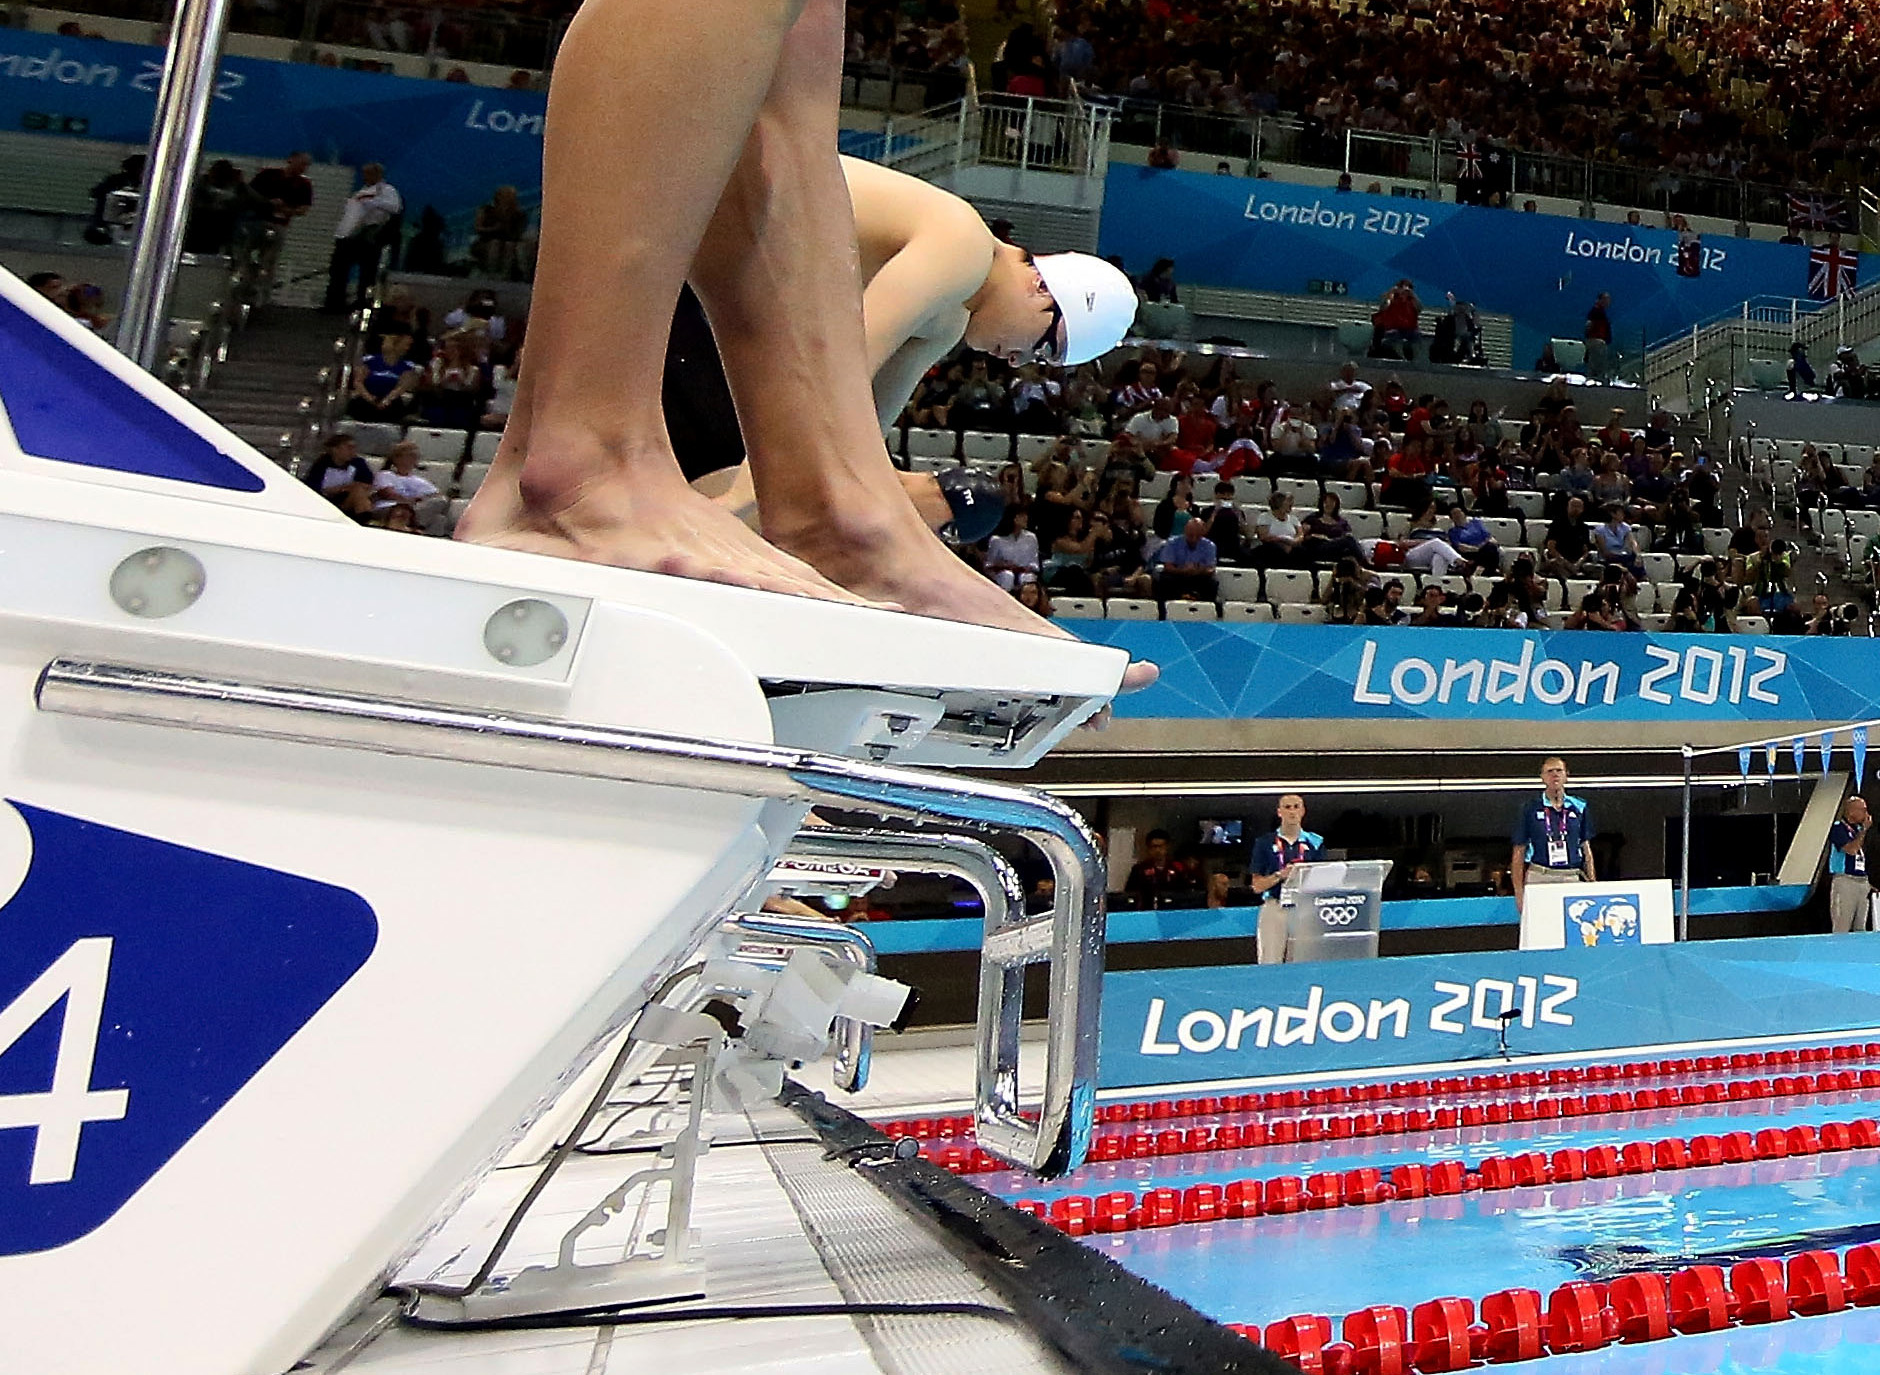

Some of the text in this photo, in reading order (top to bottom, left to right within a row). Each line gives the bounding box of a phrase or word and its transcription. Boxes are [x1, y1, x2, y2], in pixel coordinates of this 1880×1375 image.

[0, 48, 246, 102] ndon 22
[465, 99, 545, 135] Lon
[1244, 193, 1430, 238] London 2012
[1565, 231, 1727, 272] London 212
[1352, 639, 1788, 706] London 2012
[1314, 896, 1346, 906] London
[1139, 973, 1580, 1056] London 2012
[0, 936, 130, 1185] 4
